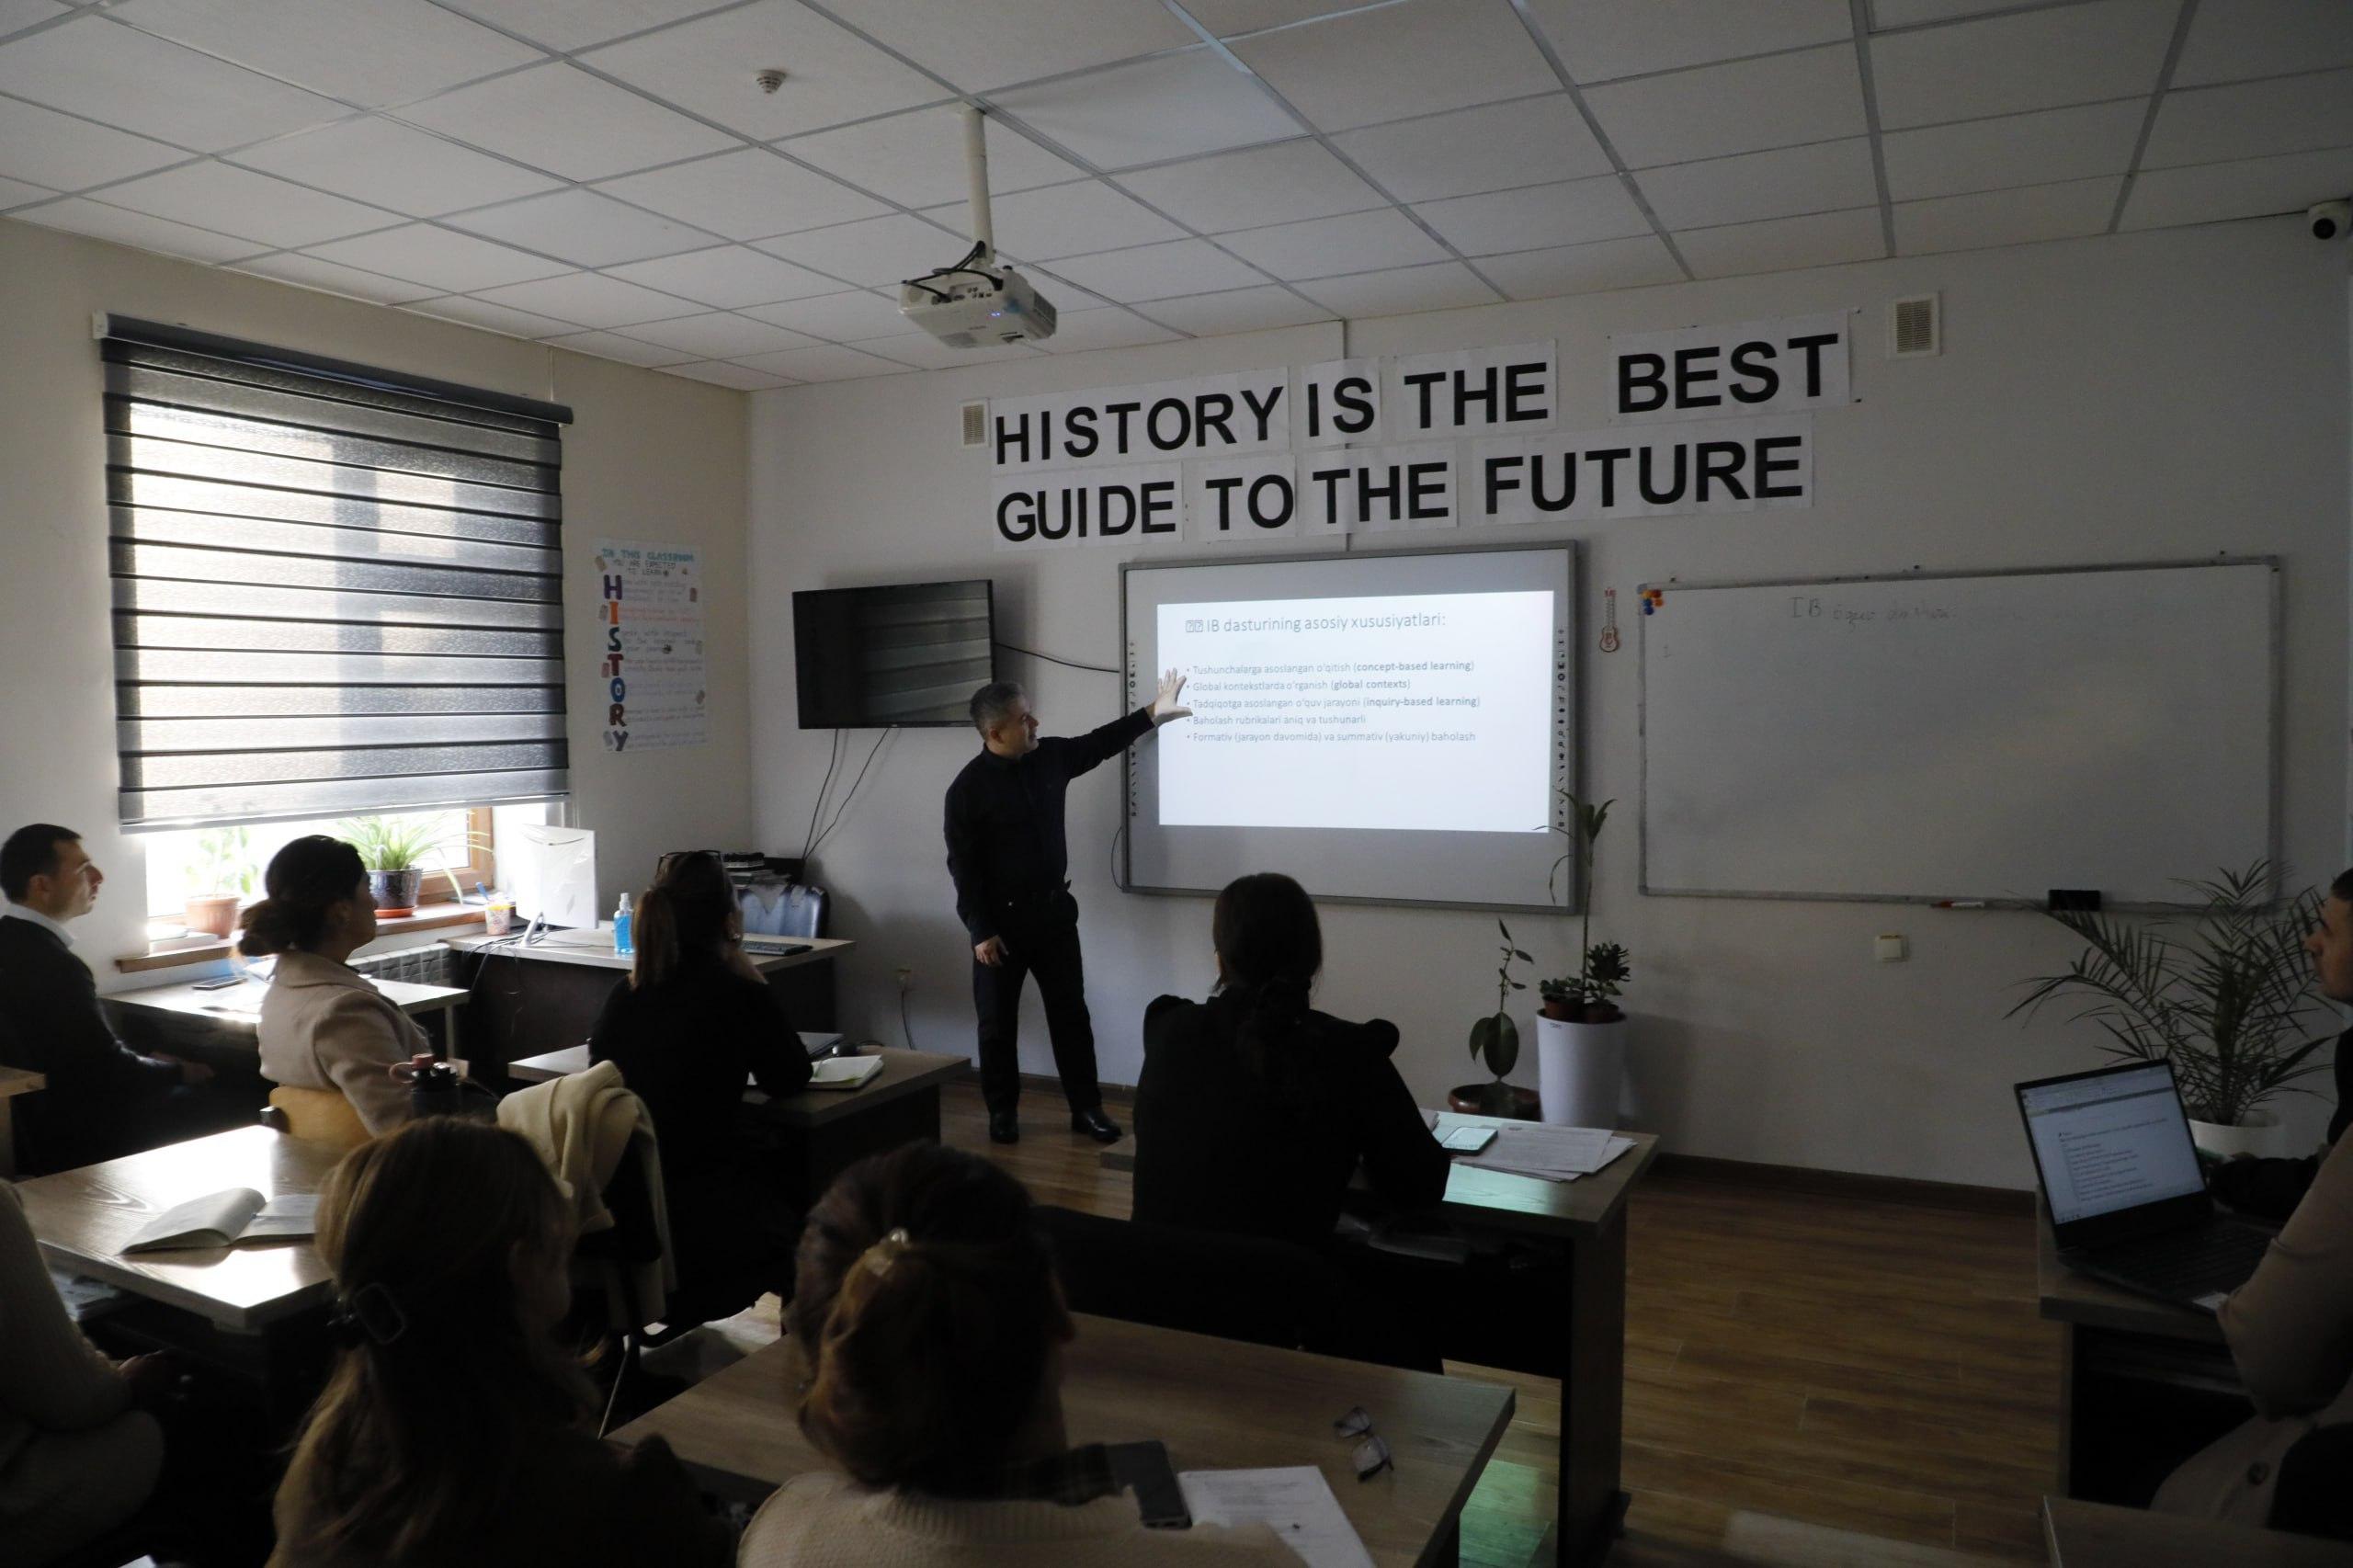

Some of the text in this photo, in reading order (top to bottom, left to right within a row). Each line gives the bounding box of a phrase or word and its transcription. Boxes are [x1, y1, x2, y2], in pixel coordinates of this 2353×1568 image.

[996, 334, 1838, 464] HISTORY IS THE BEST
[997, 437, 1802, 541] GUIDE TO THE FUTURE
[1788, 597, 1822, 618] IB
[1207, 613, 1447, 632] IB dasturining asosiy xususiyatlari:
[1193, 665, 1261, 676] Tushunchalarga
[1265, 664, 1313, 675] asoslangan
[1353, 661, 1427, 673] (concept-based
[1430, 661, 1474, 673] learning)
[1193, 681, 1221, 691] Global
[1224, 680, 1284, 691] kontekstlarda
[1331, 679, 1362, 691] (global
[1366, 679, 1410, 690] contexts)
[1193, 699, 1241, 710] Tadqiqotga
[1245, 699, 1292, 709] asoslangan
[1324, 698, 1360, 709] jarayoni
[1363, 697, 1432, 708] (inquiry-based
[1436, 697, 1480, 707] learning)
[1194, 715, 1233, 725] Baholash
[1236, 715, 1280, 725] rubrikalari
[1319, 715, 1366, 725] tushunarli
[1193, 733, 1232, 742] Formativ
[1234, 733, 1271, 743] (jarayon
[1274, 733, 1322, 743] davomida)
[1337, 733, 1383, 742] summativ
[1385, 733, 1429, 743] (yakuniy)
[1432, 733, 1475, 742] baholash
